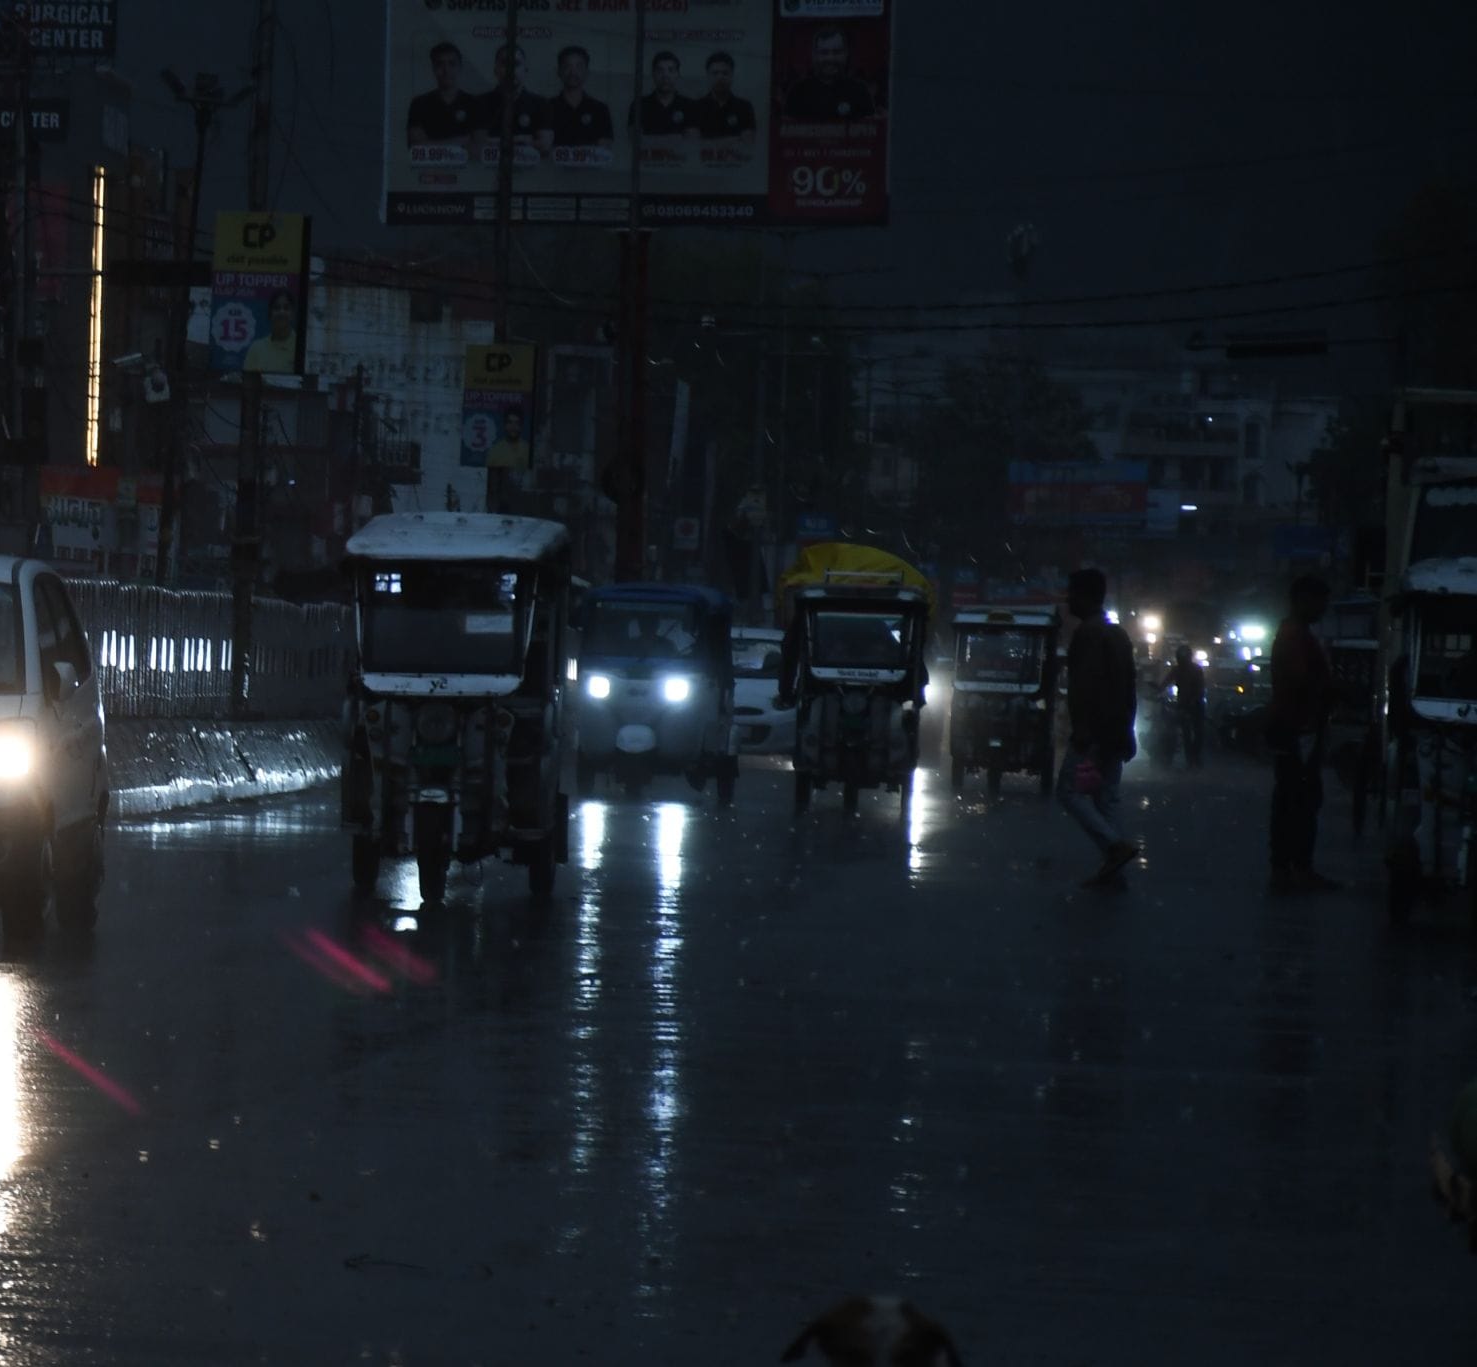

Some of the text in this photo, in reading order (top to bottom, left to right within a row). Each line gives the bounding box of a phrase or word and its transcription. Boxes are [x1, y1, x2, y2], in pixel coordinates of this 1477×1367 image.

[15, 5, 112, 25] SURGICAL
[28, 29, 104, 49] CENTER
[792, 165, 867, 197] 90%
[243, 222, 276, 249] CP
[215, 273, 289, 289] UP TOPPER
[220, 319, 247, 341] 15
[485, 353, 512, 372] CP
